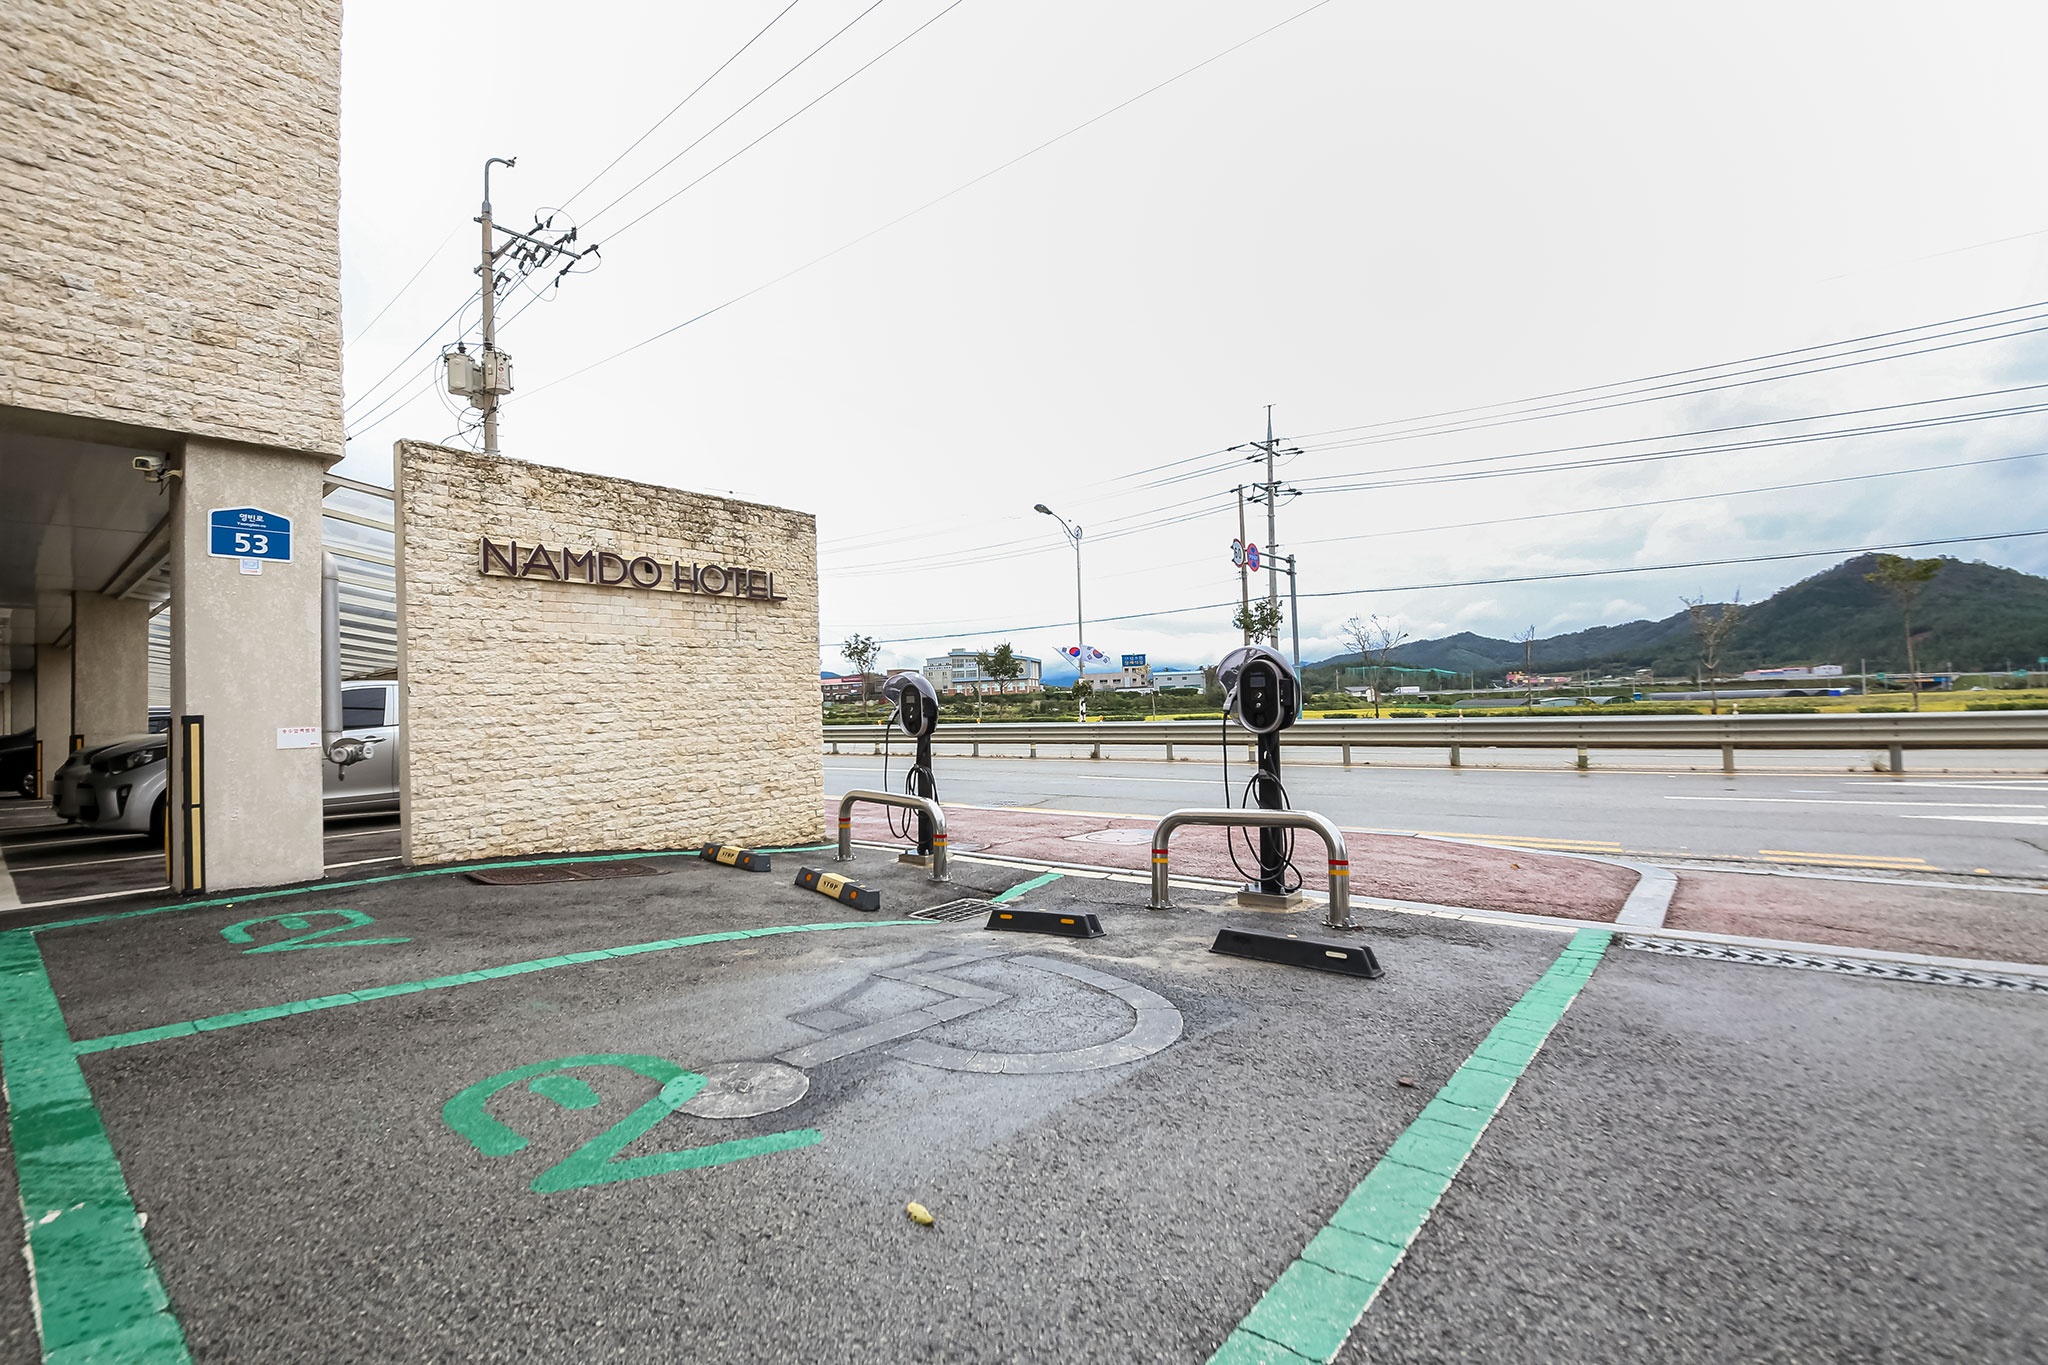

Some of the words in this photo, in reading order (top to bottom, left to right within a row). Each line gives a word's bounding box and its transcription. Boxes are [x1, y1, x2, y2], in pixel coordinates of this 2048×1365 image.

[239, 513, 264, 522] 영빈로
[235, 533, 268, 554] 53
[479, 535, 663, 588] NAMDO
[672, 560, 788, 601] HOTEL
[722, 851, 735, 859] STOP
[823, 880, 838, 890] STOP
